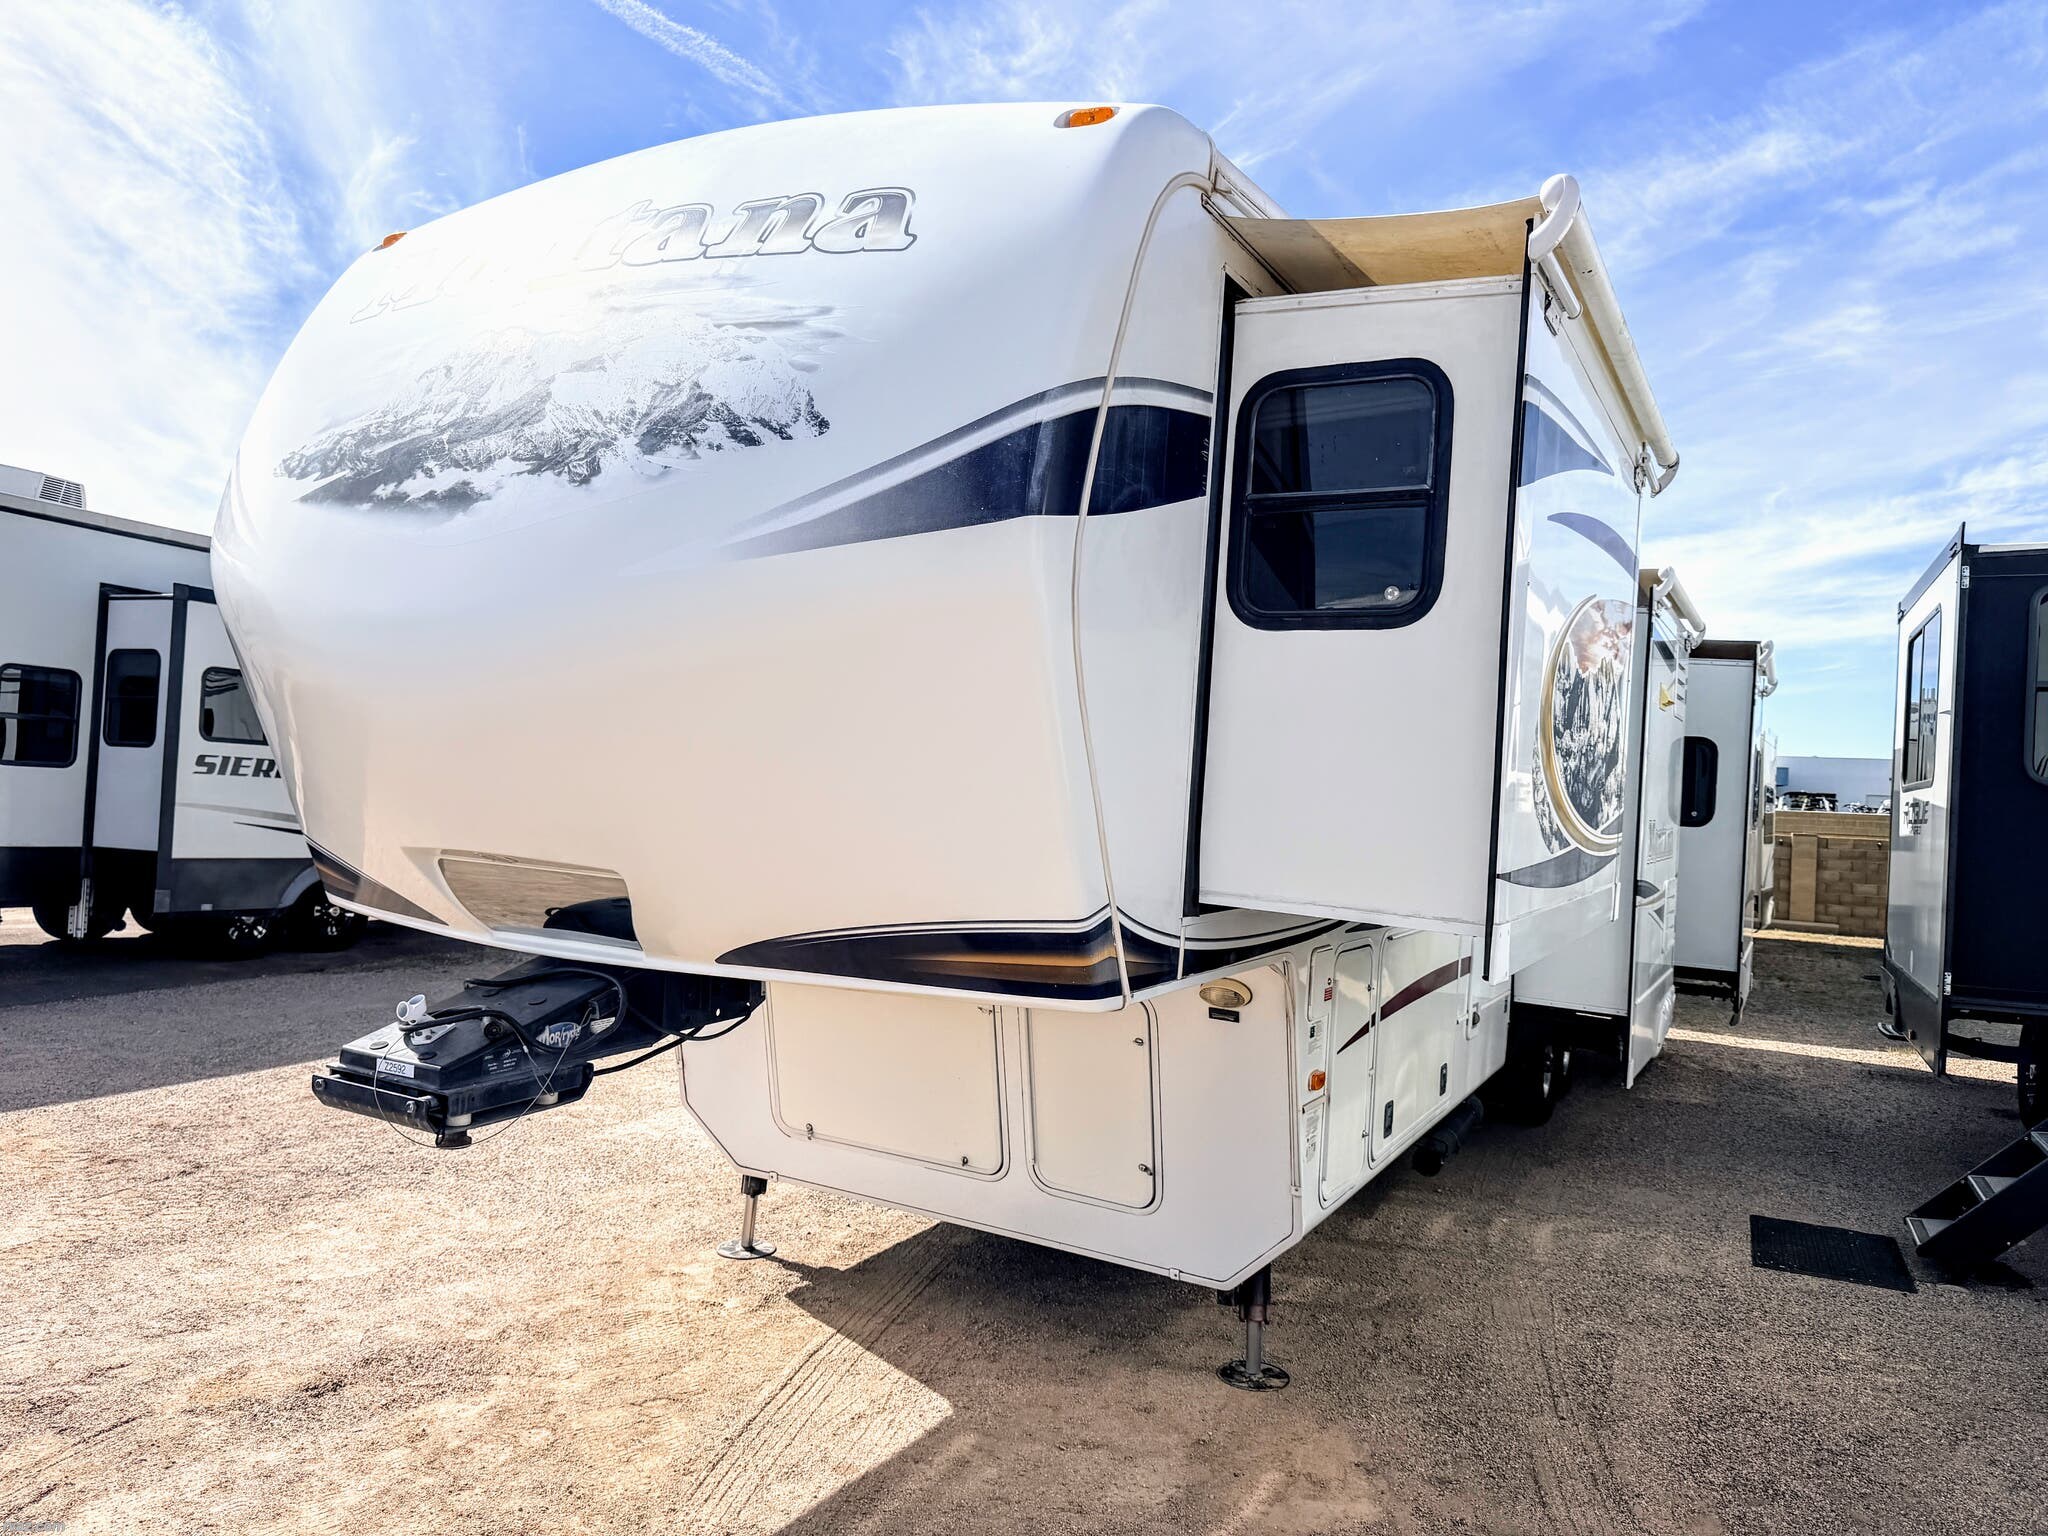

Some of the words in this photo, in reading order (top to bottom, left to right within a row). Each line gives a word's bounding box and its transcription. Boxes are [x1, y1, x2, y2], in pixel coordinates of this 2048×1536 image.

[350, 187, 919, 325] tana
[192, 754, 282, 779] SIER
[384, 1061, 406, 1075] Z2592
